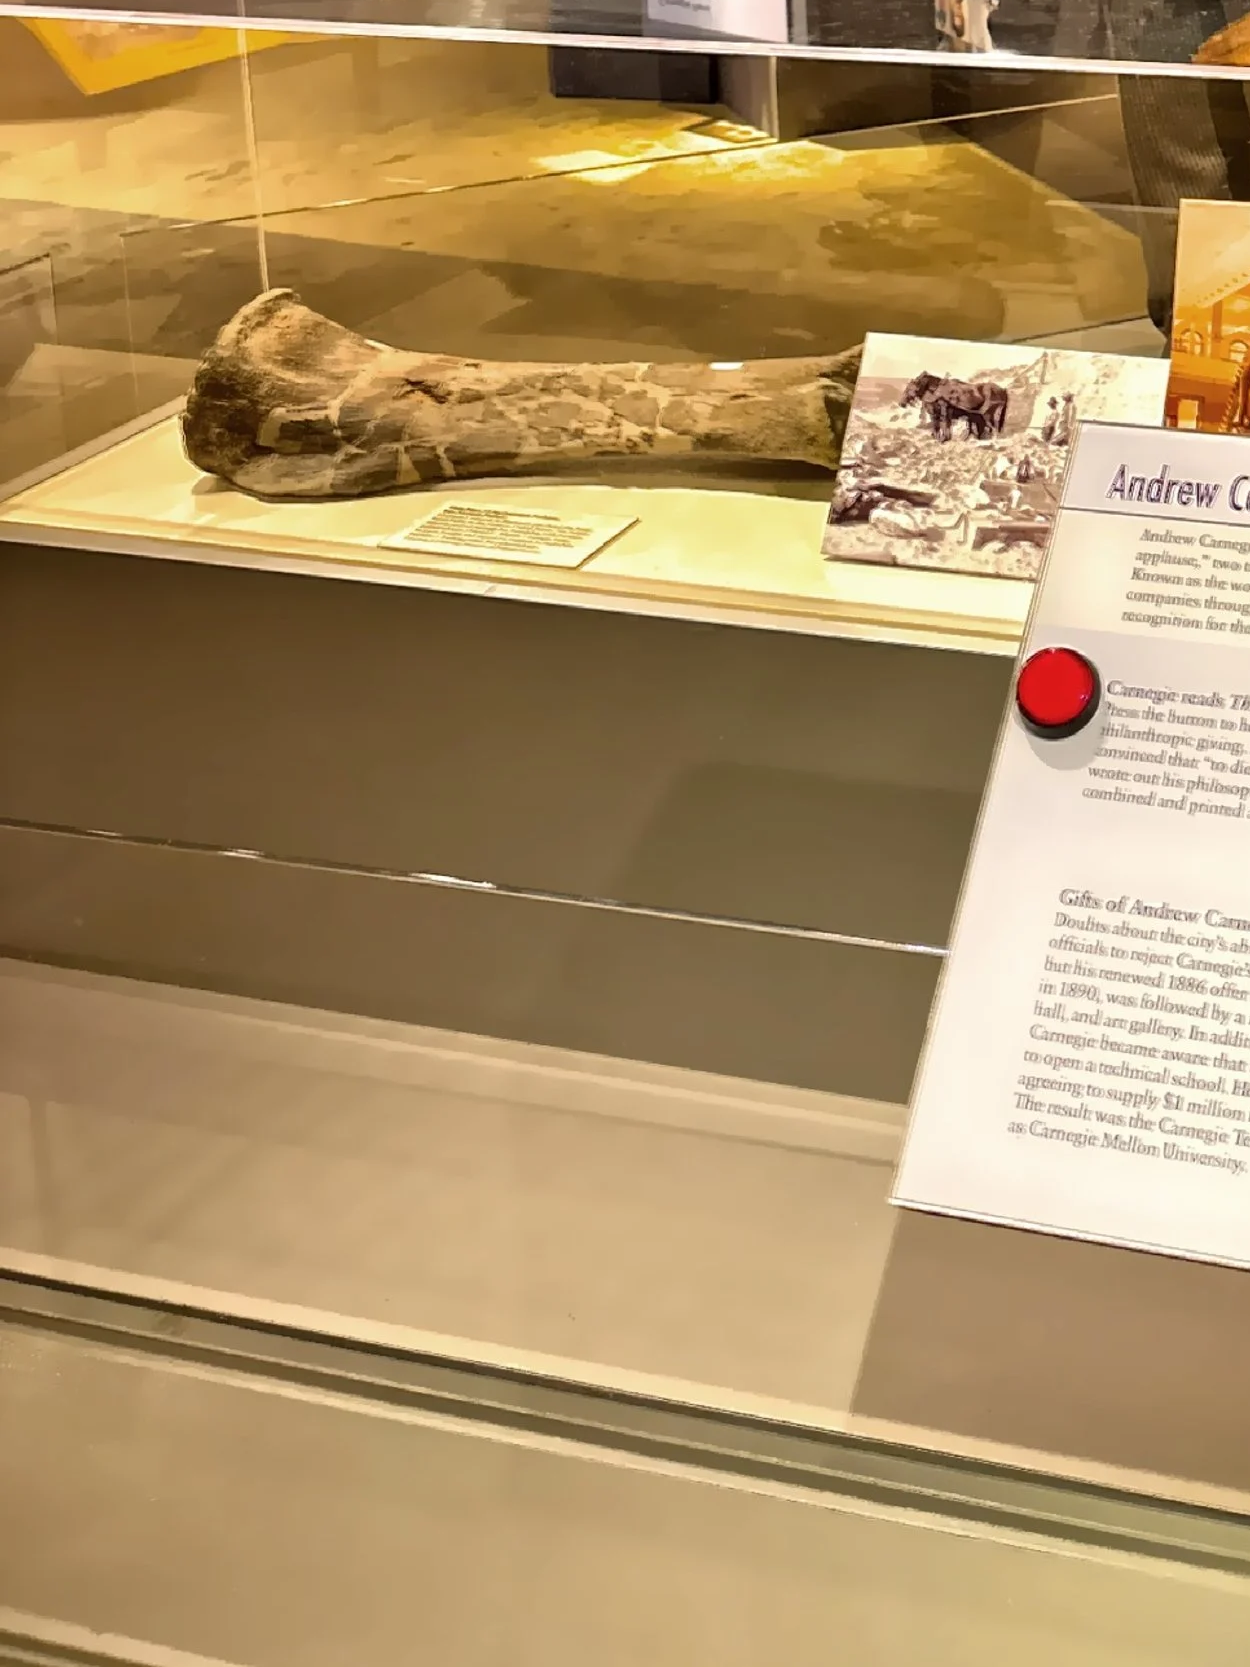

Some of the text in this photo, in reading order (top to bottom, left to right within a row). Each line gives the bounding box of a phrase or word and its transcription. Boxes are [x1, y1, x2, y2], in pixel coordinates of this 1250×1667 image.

[1104, 463, 1224, 509] Andrew
[1139, 528, 1197, 547] Andrew
[1130, 566, 1185, 586] Known
[1184, 576, 1203, 588] as
[1203, 573, 1229, 591] the
[1211, 558, 1243, 572] two
[1125, 590, 1203, 609] companies
[1120, 611, 1204, 630] recognition
[1204, 615, 1229, 632] for
[1102, 679, 1181, 706] Carnegie
[1179, 691, 1227, 710] reads
[1081, 785, 1158, 807] combined
[1156, 794, 1189, 811] and
[1187, 798, 1246, 819] printed
[1058, 888, 1104, 910] Gifts
[1104, 894, 1131, 915] of
[1127, 898, 1203, 924] Andrew
[1053, 911, 1112, 935] Doubts
[1111, 919, 1160, 942] about
[1159, 926, 1189, 946] the
[1013, 1091, 1050, 1114] The
[1046, 1101, 1094, 1122] result
[1094, 1110, 1132, 1128] was
[1128, 1110, 1161, 1133] the
[1157, 1116, 1235, 1147] Carnegie
[1006, 1119, 1249, 1176] as Carnegie Mellon University.
